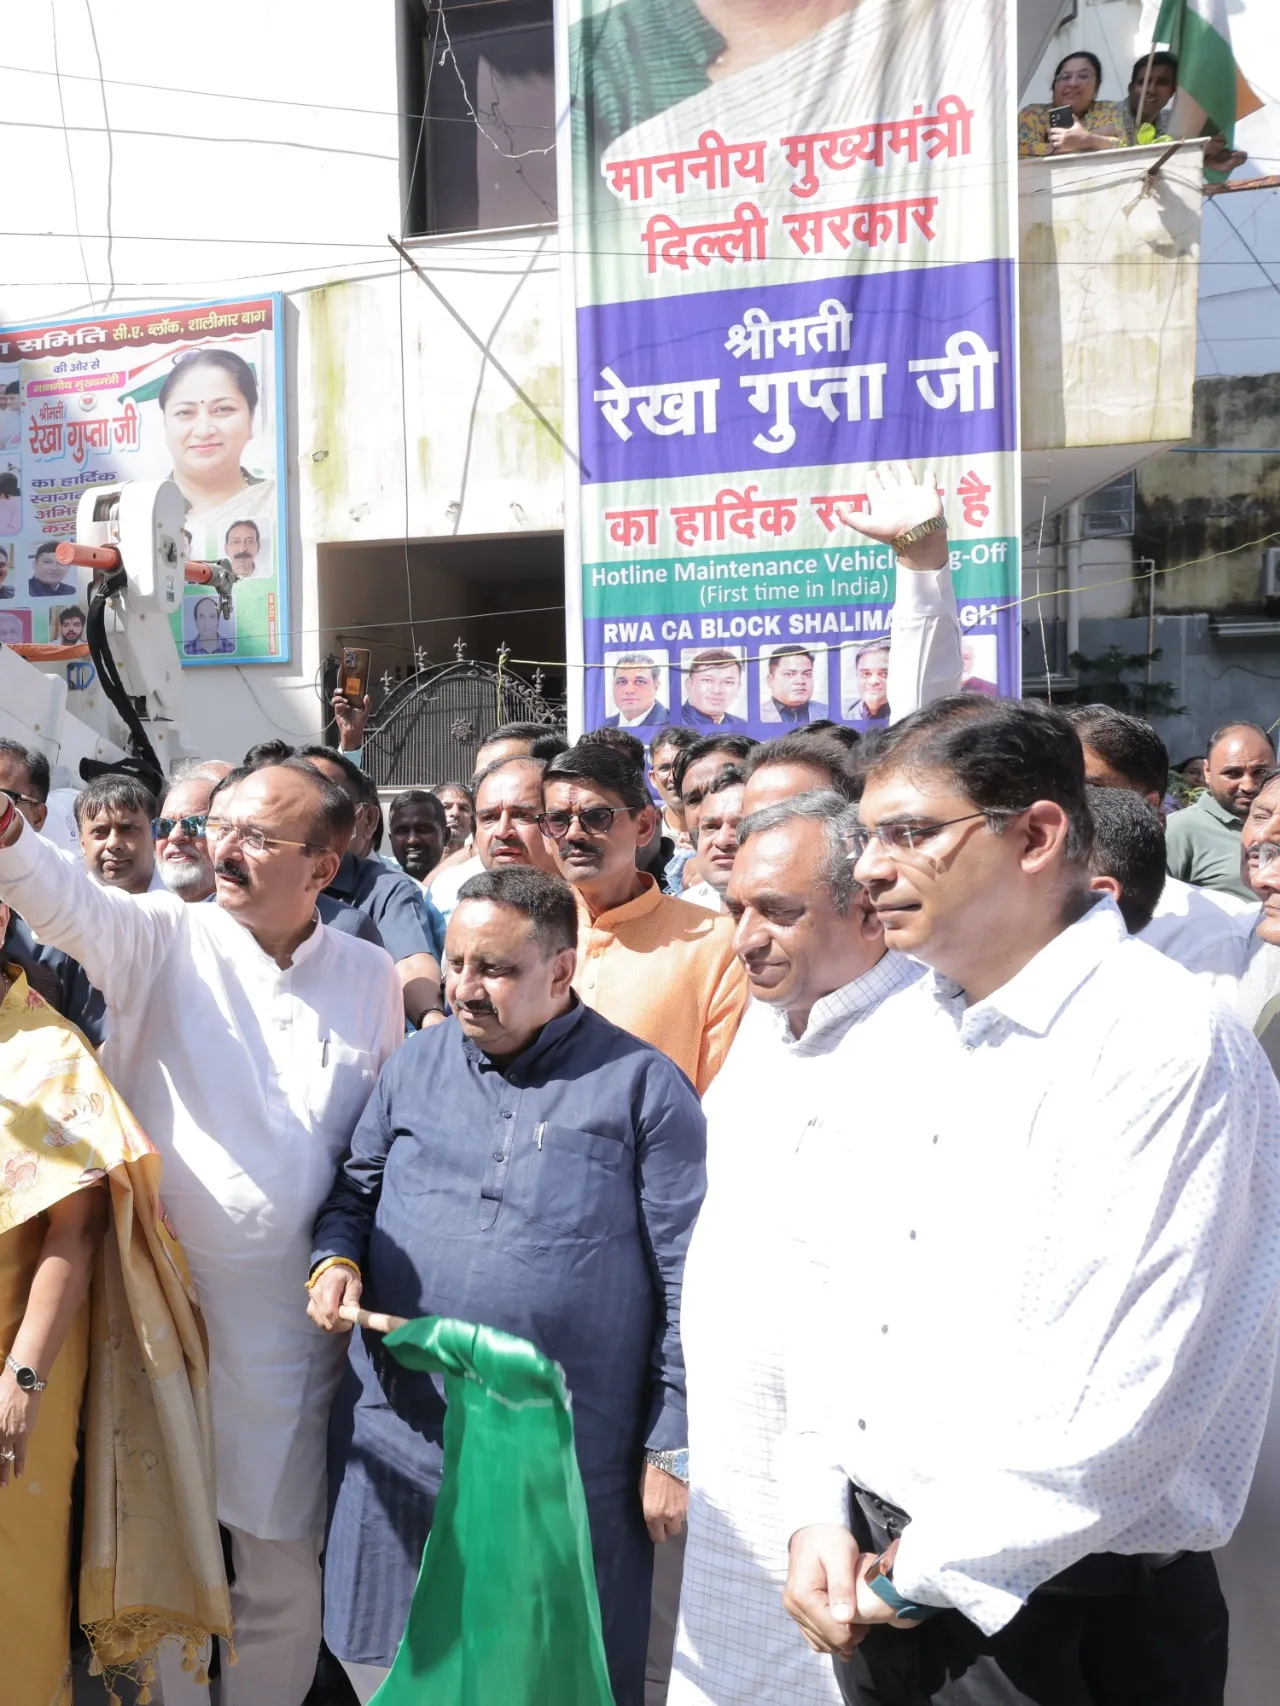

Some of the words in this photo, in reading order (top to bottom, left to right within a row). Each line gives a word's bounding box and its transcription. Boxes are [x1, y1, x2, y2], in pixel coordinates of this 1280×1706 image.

[606, 130, 767, 201] माननीय
[780, 94, 974, 197] मुख्यमंत्री
[642, 202, 768, 274] दिल्ली
[783, 196, 938, 255] सरकार
[17, 326, 108, 351] समिति
[112, 322, 144, 341] सी.ए.
[188, 311, 239, 332] शालीमार
[241, 309, 266, 324] बाग
[724, 298, 852, 360] श्रीमती
[33, 379, 72, 393] माननीय
[53, 361, 67, 374] की
[70, 360, 88, 372] ओर
[90, 358, 100, 370] से
[39, 400, 64, 420] श्रीमती
[594, 366, 720, 442] रेखा
[740, 362, 887, 454] गुप्ता
[909, 330, 999, 413] जी
[29, 414, 62, 454] रेखा
[67, 419, 109, 463] गुप्ता
[112, 403, 138, 444] जी
[29, 491, 84, 504] स्वाग
[30, 478, 56, 488] का
[60, 470, 117, 487] हार्दिक
[957, 470, 991, 527] है
[606, 508, 658, 546] का
[671, 485, 797, 546] हार्दिक
[592, 564, 667, 587] Hotline
[675, 558, 817, 582] Maintenance
[824, 549, 897, 573] Vehicl
[949, 541, 1008, 571] g-Off
[700, 584, 748, 608] (First
[754, 581, 800, 601] time
[806, 579, 824, 598] in
[831, 574, 888, 599] India)
[603, 622, 655, 644] RWA
[661, 620, 693, 641] CA
[701, 614, 781, 639] BLOCK
[789, 608, 893, 636] SHALIMA
